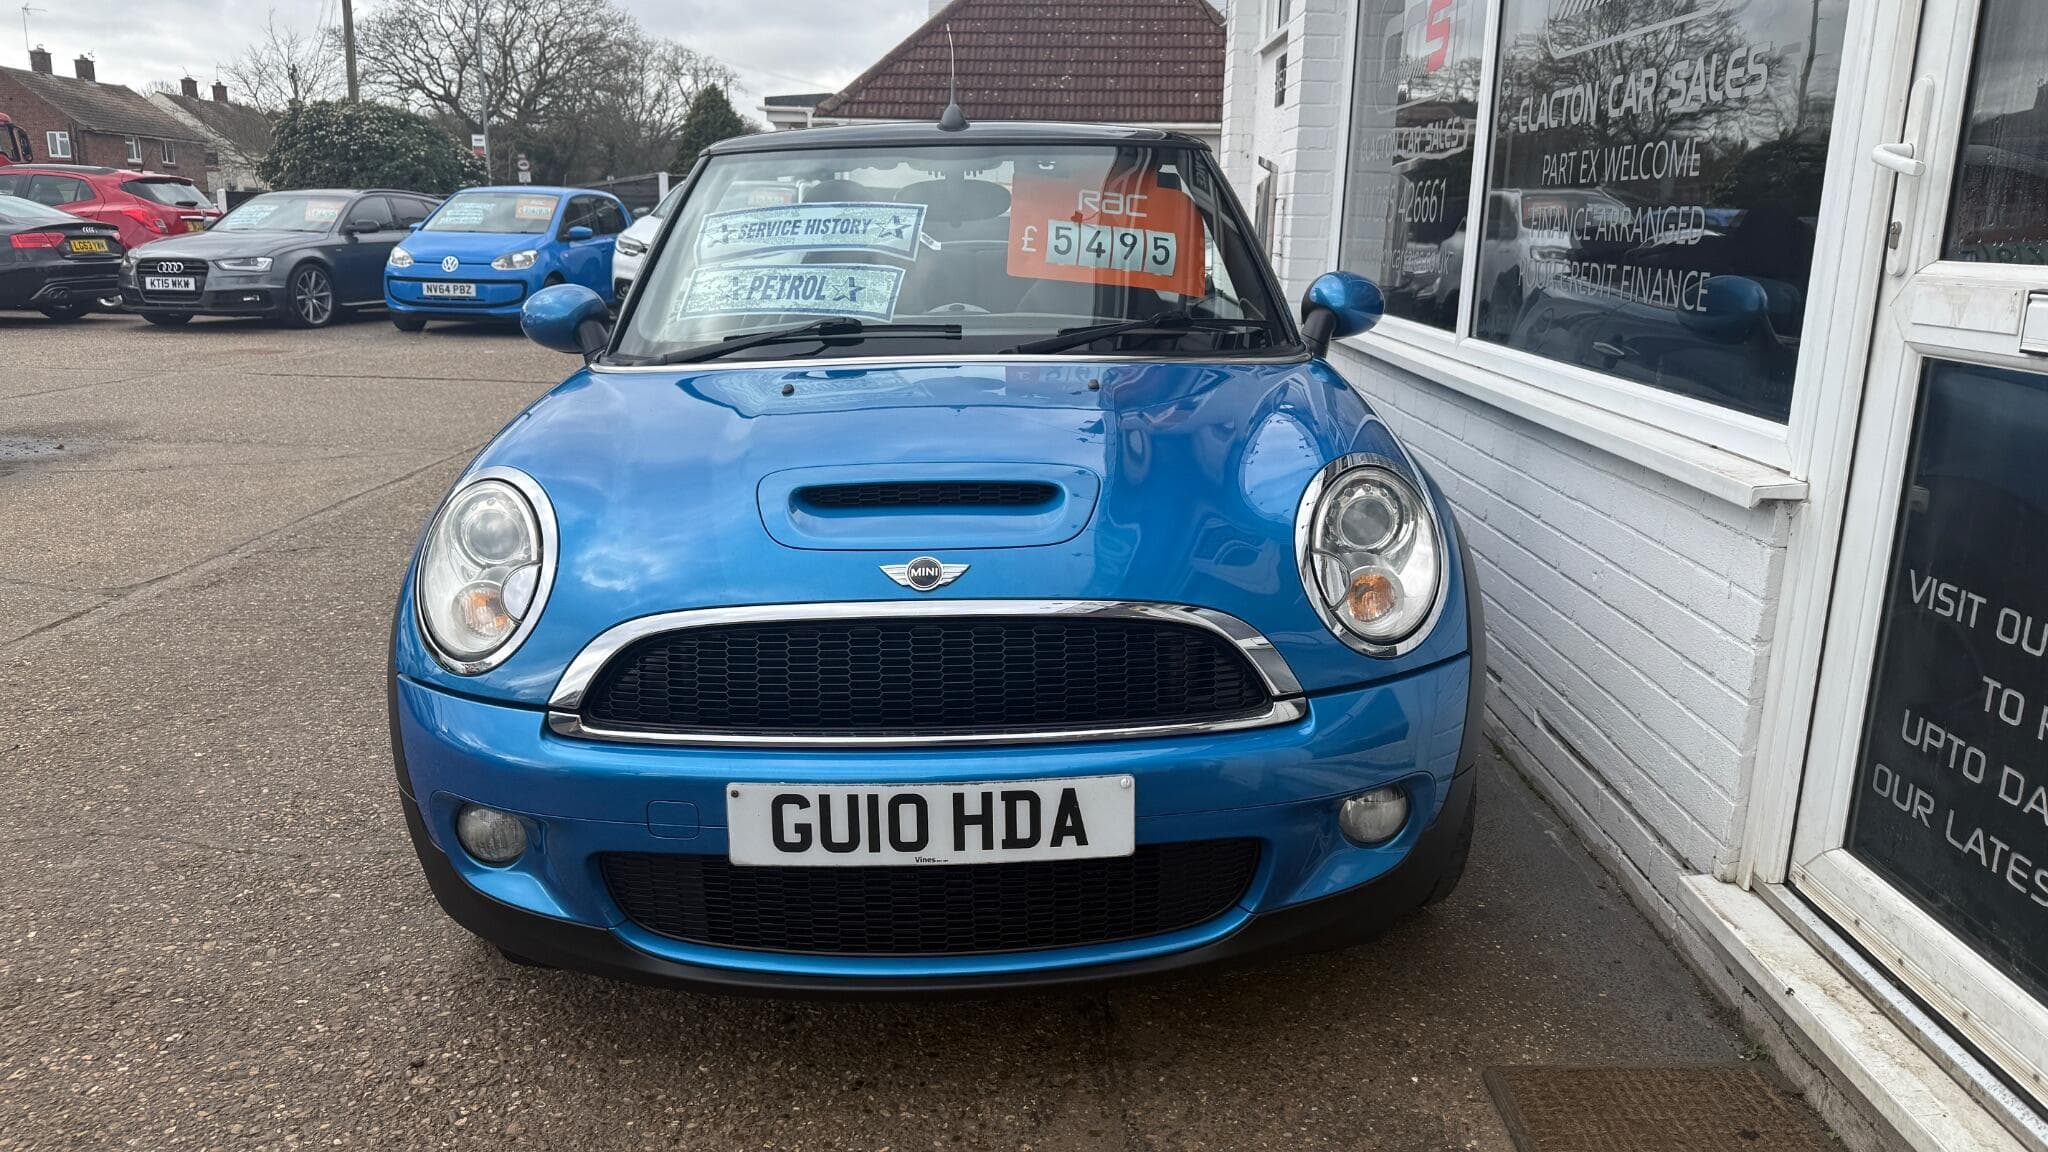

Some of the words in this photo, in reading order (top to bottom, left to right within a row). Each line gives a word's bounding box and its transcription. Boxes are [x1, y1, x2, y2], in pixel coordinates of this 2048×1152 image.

[1518, 80, 1600, 133] CLACTON
[1607, 67, 1658, 117] CAR
[1667, 47, 1772, 109] SALES
[1402, 125, 1422, 153] CAR
[1424, 115, 1461, 152] SALES
[1541, 151, 1578, 186] PART
[1579, 148, 1601, 184] EX
[1603, 136, 1703, 183] WELCOME
[1398, 177, 1447, 223] 426661
[738, 219, 801, 240] SERVICE
[804, 217, 873, 236] HISTORY
[1528, 207, 1593, 241] FINANCE
[1595, 205, 1706, 246] ARRANGED
[150, 278, 170, 289] KT15
[426, 284, 451, 294] NV64
[453, 284, 472, 295] PBZ
[748, 275, 828, 301] PETROL
[1561, 259, 1617, 299] CREDIT
[1620, 264, 1712, 313] FINANCE
[911, 566, 939, 577] MINI
[1910, 569, 1987, 629] VISIT
[1982, 675, 2025, 726] TO
[1901, 709, 1986, 784] UPTO
[1872, 763, 1935, 828] OUR
[770, 793, 930, 853] GU10
[952, 787, 1090, 852] HDA
